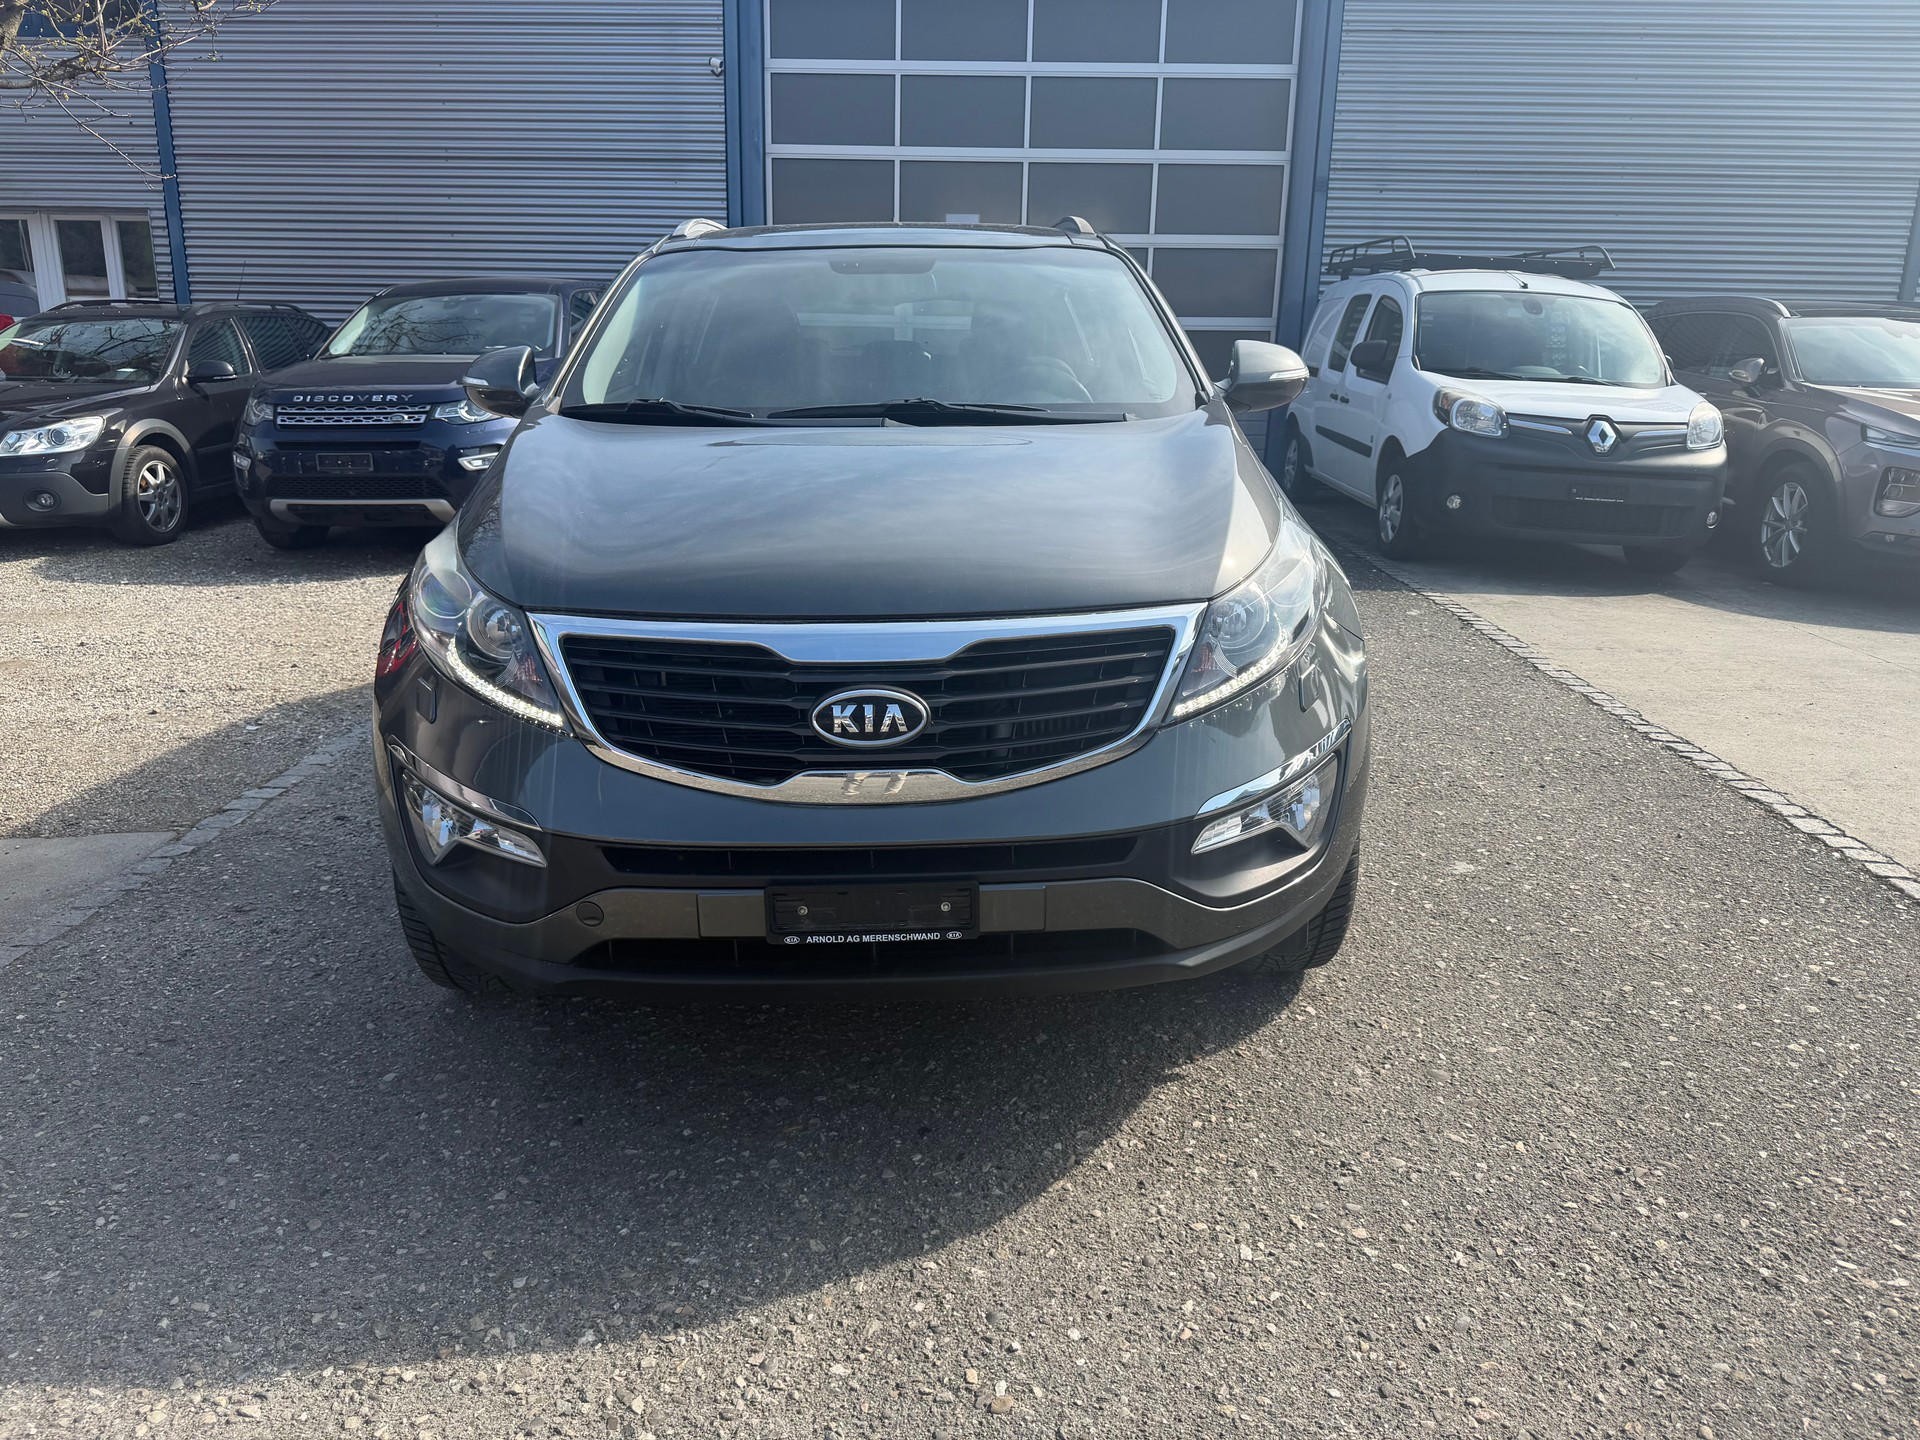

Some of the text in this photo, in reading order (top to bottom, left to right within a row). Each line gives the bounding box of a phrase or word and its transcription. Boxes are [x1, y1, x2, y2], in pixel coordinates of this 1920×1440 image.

[293, 394, 414, 402] DISCOVERY
[831, 704, 908, 733] KIA
[806, 935, 845, 944] ARNOLD
[846, 935, 860, 943] AG
[862, 932, 941, 943] MERENSCHWAND
